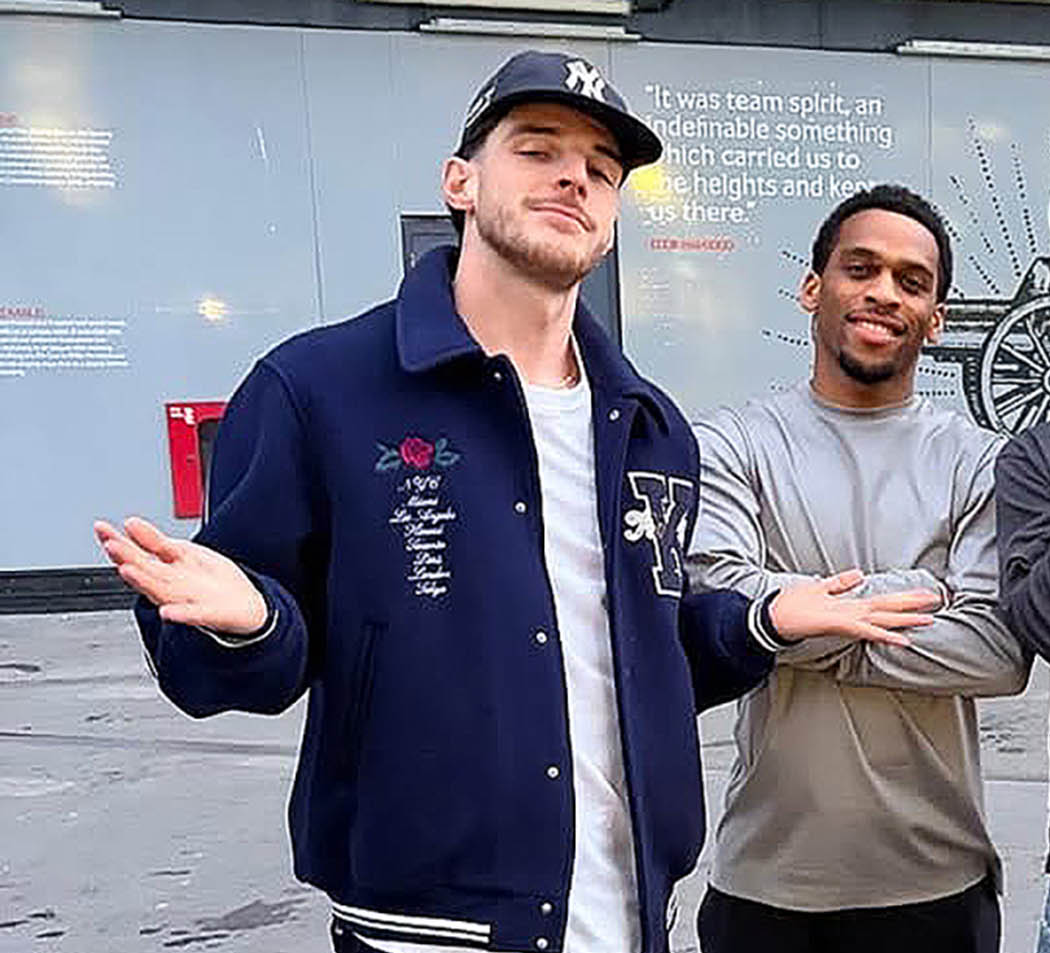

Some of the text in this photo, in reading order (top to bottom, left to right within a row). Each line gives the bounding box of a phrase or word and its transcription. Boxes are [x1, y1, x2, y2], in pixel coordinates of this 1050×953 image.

[645, 84, 882, 118] "It was team spirit, an
[775, 121, 892, 149] something
[664, 142, 860, 171] hich carried us to
[694, 169, 777, 200] heights
[783, 174, 824, 197] and
[650, 205, 677, 221] us
